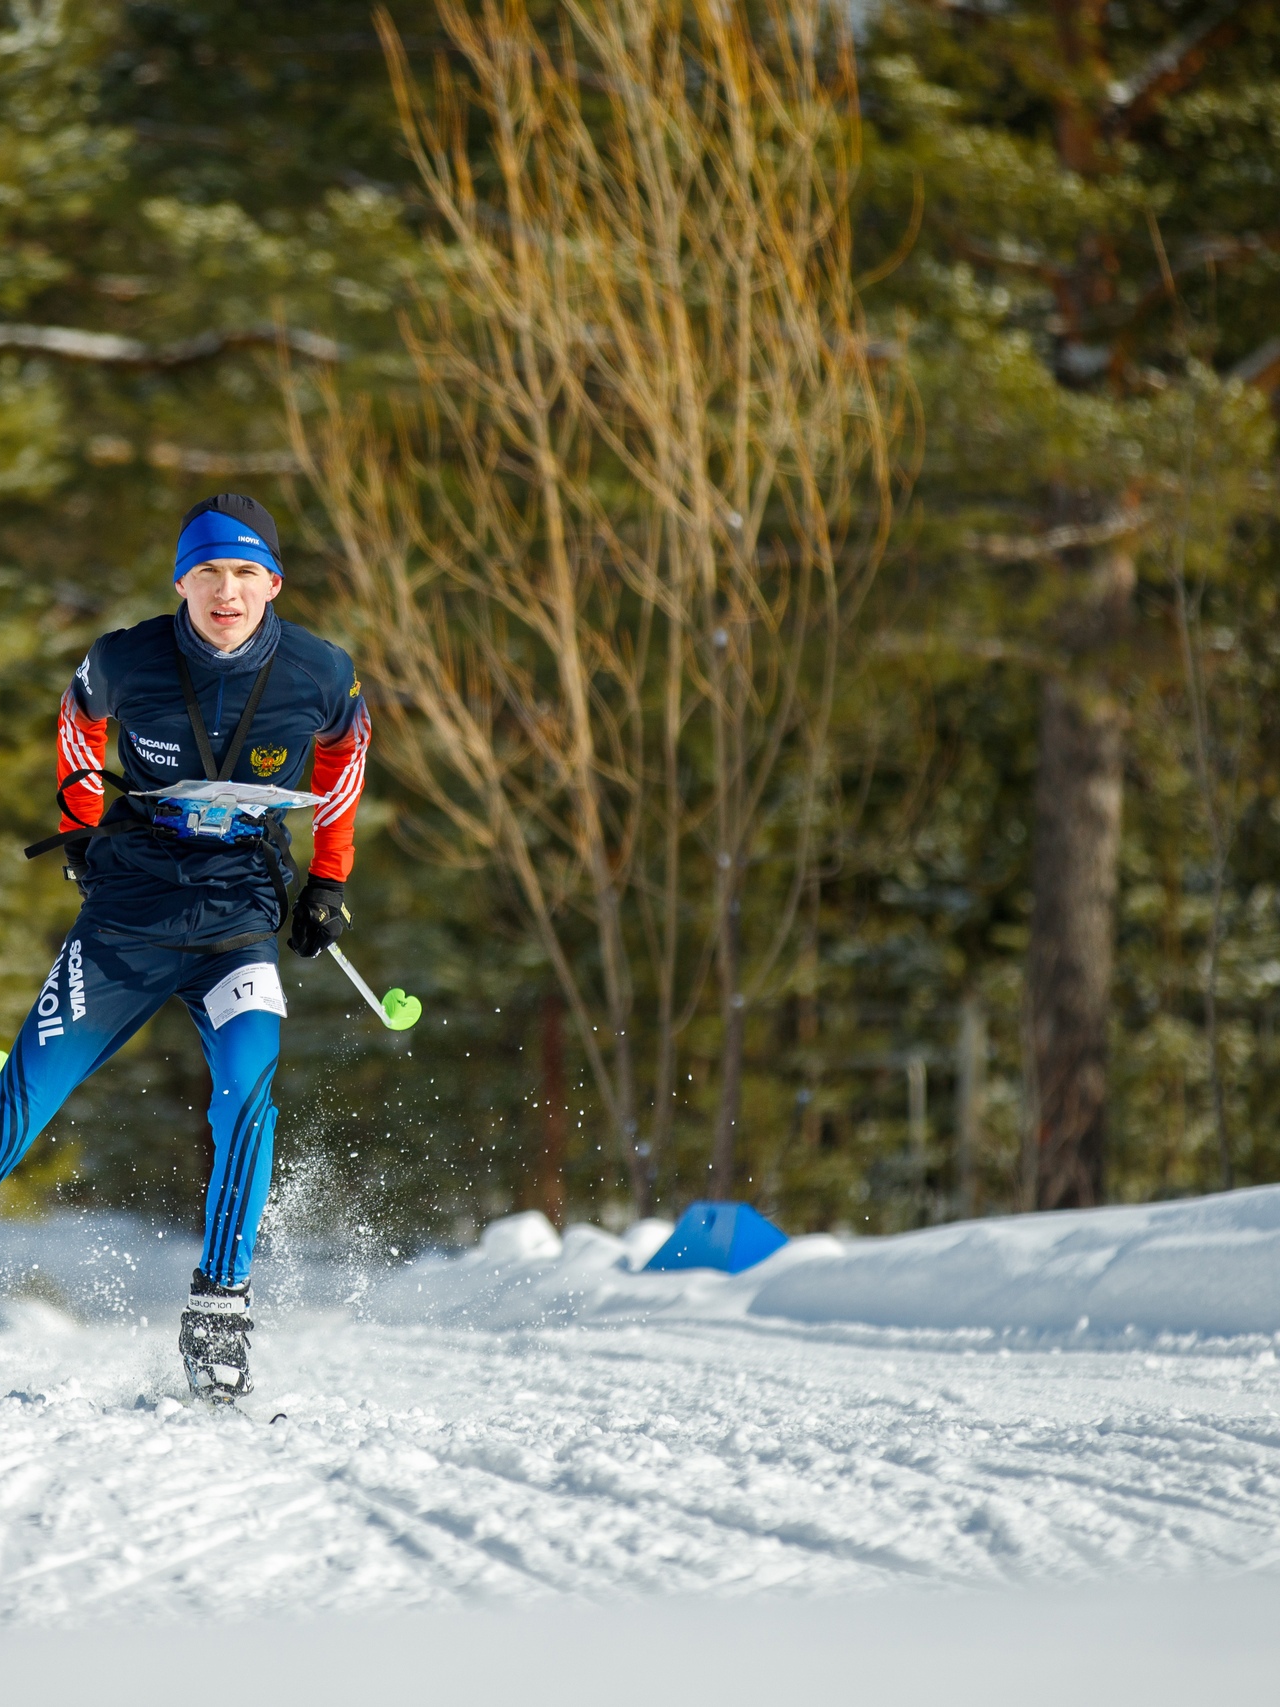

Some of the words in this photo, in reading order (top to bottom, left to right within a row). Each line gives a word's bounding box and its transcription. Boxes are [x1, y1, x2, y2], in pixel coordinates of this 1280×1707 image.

[134, 743, 179, 767] UKOIL
[139, 738, 181, 752] SCANIA
[68, 939, 86, 1022] SCANIA
[231, 981, 254, 1002] 17
[38, 941, 67, 1046] UKOIL
